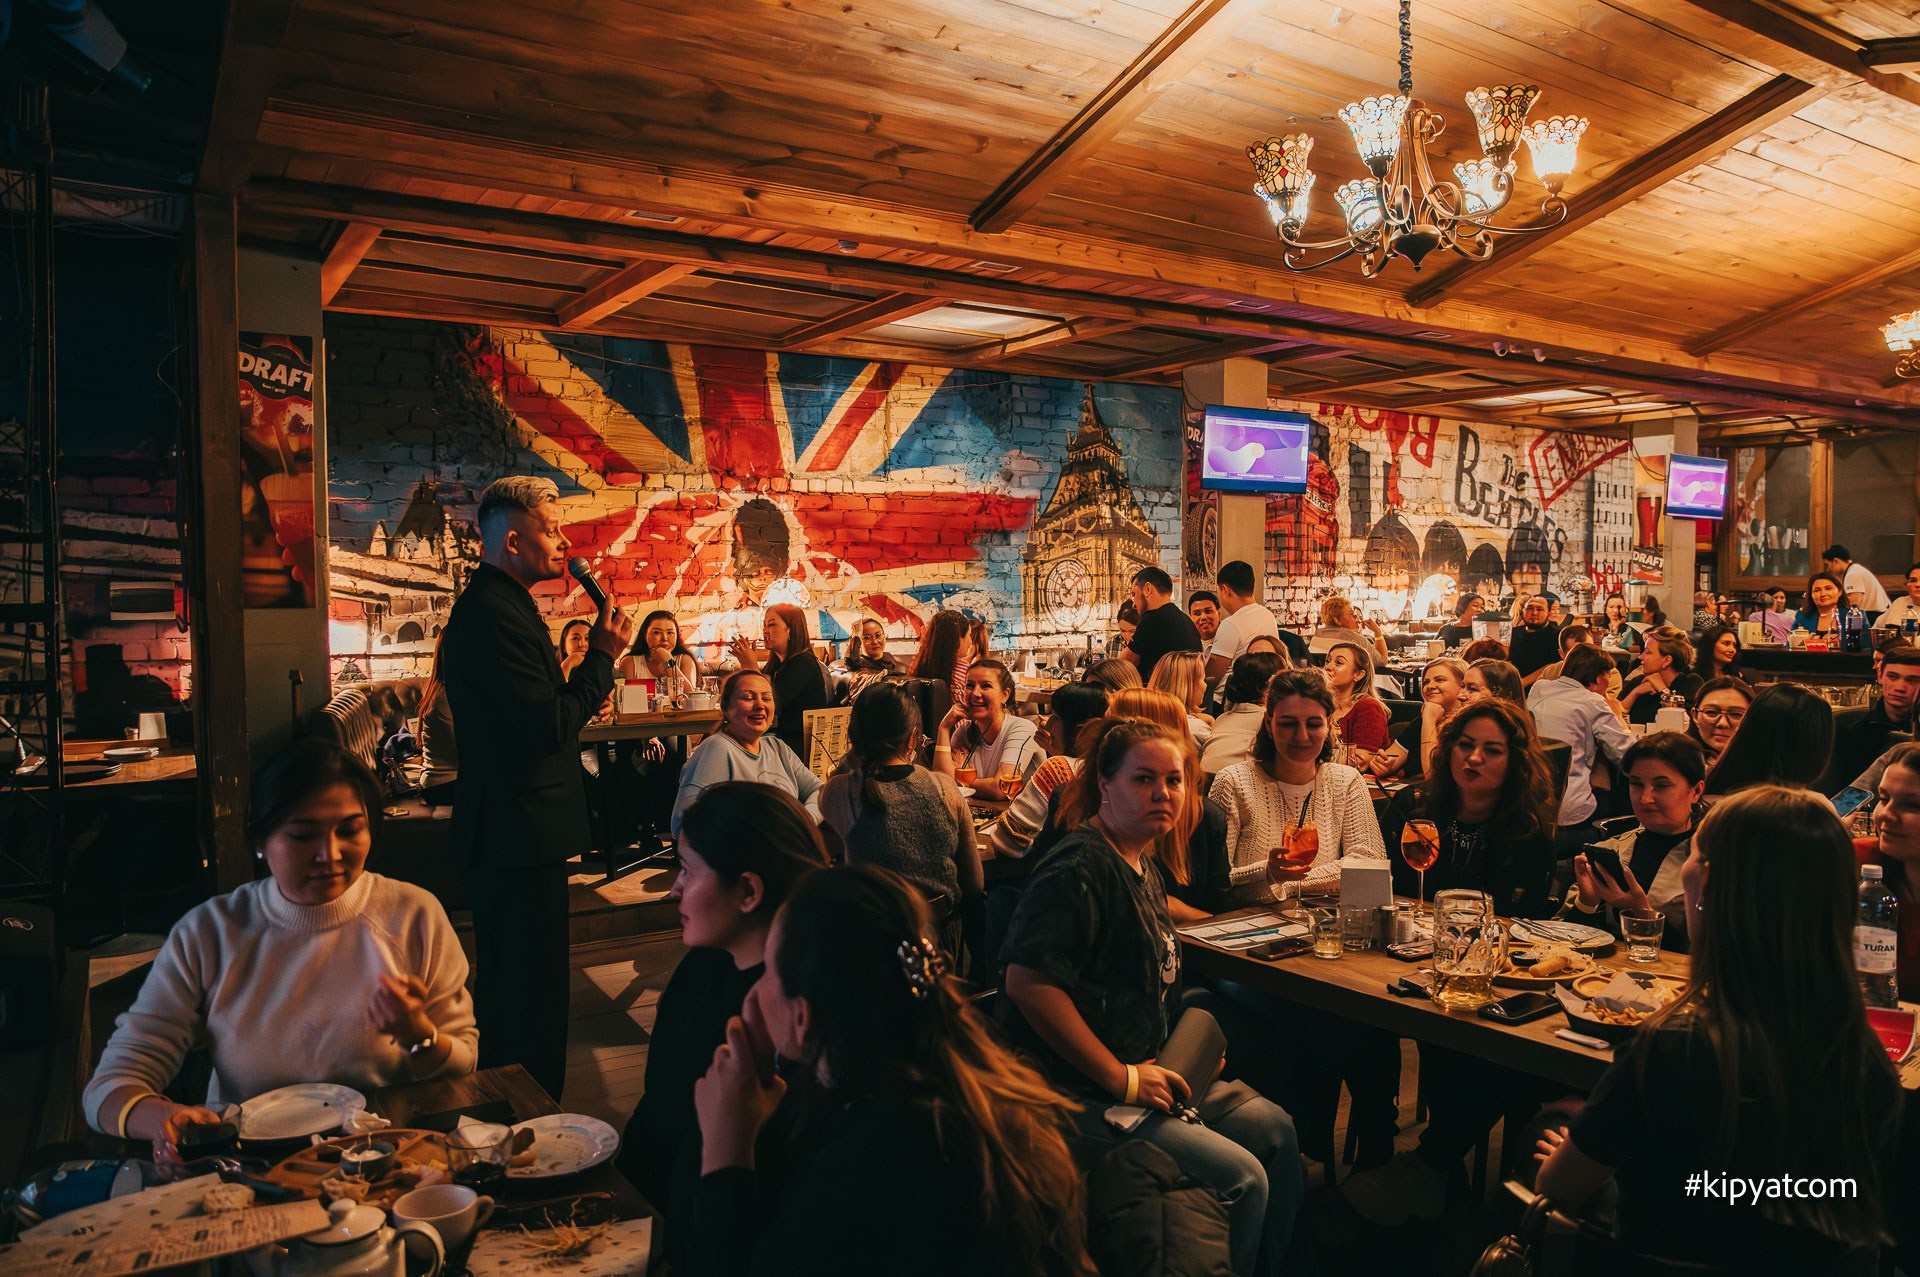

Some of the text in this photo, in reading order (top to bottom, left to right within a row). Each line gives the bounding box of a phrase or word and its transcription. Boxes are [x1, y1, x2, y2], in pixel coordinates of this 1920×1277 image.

[238, 351, 314, 392] DRAFT
[1187, 426, 1205, 443] DRA
[1632, 550, 1664, 569] DRAFT
[1863, 943, 1896, 953] TURAN
